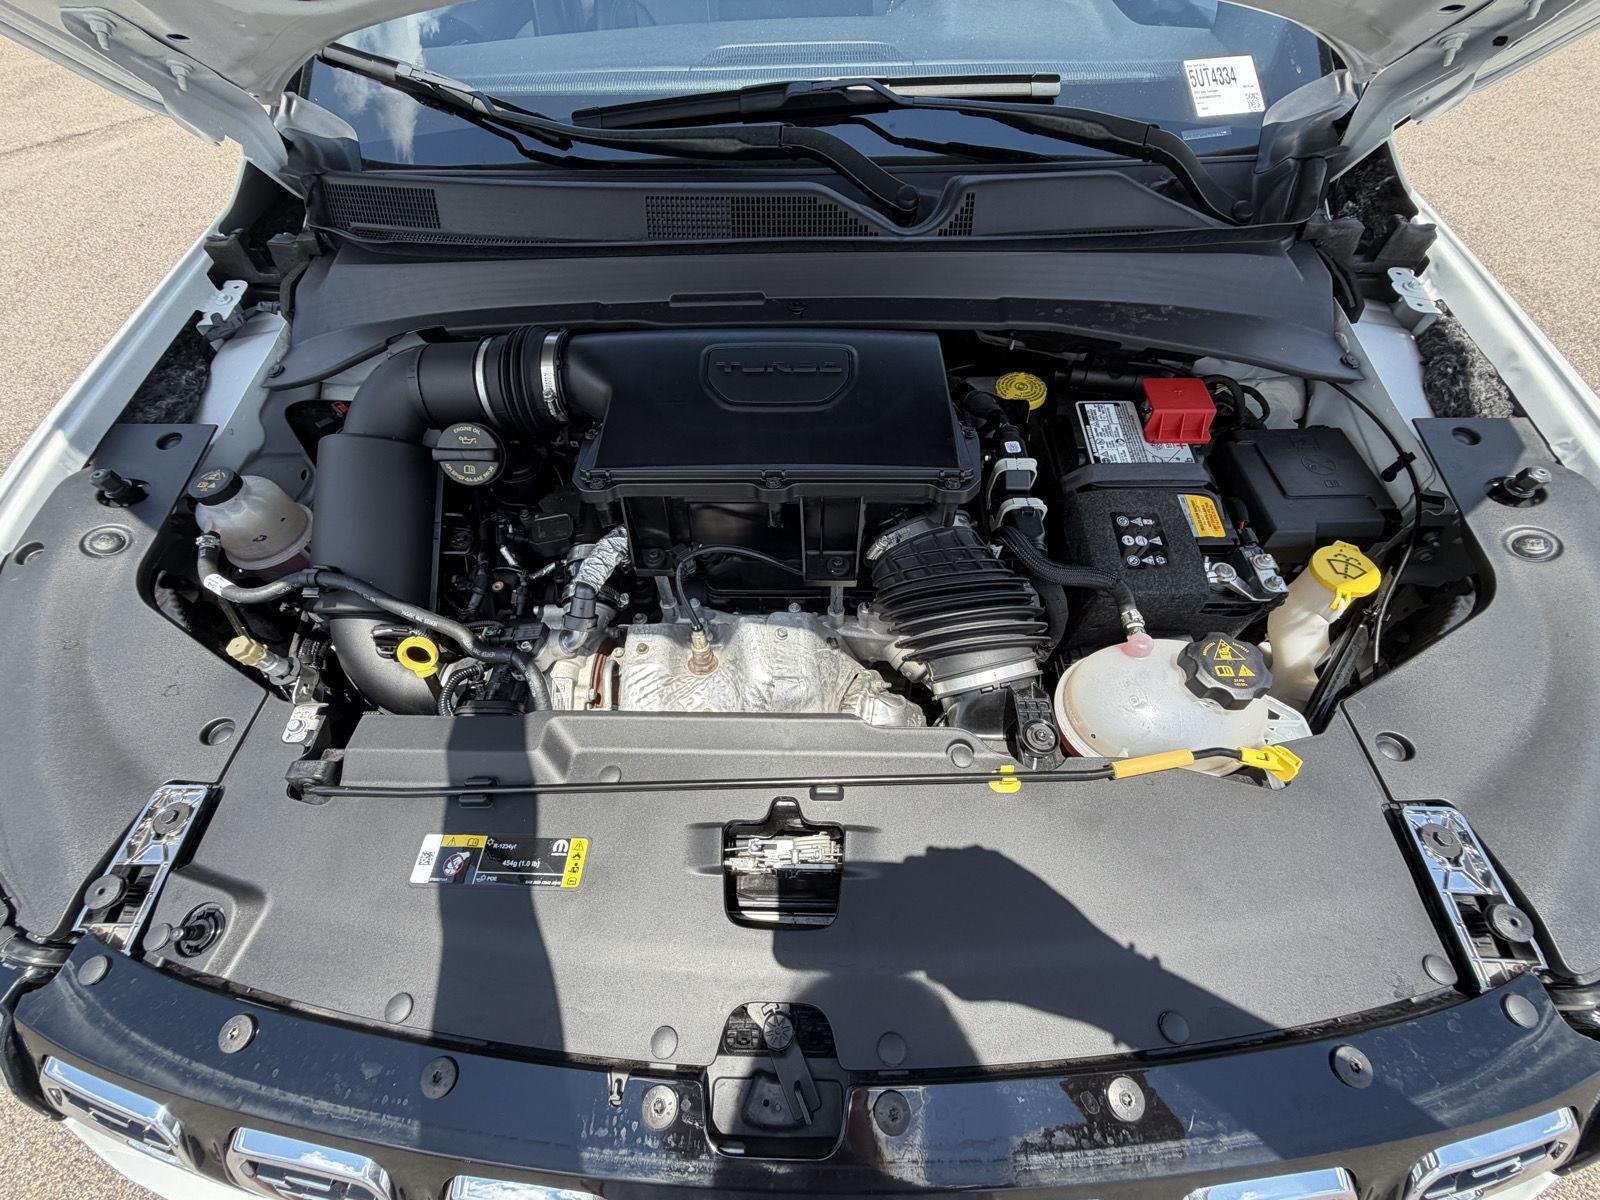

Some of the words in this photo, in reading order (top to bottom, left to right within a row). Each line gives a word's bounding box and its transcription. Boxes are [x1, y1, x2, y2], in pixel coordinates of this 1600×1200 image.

[1188, 66, 1237, 87] 5UT4334
[453, 426, 472, 434] ENGINE
[472, 427, 481, 436] OIL
